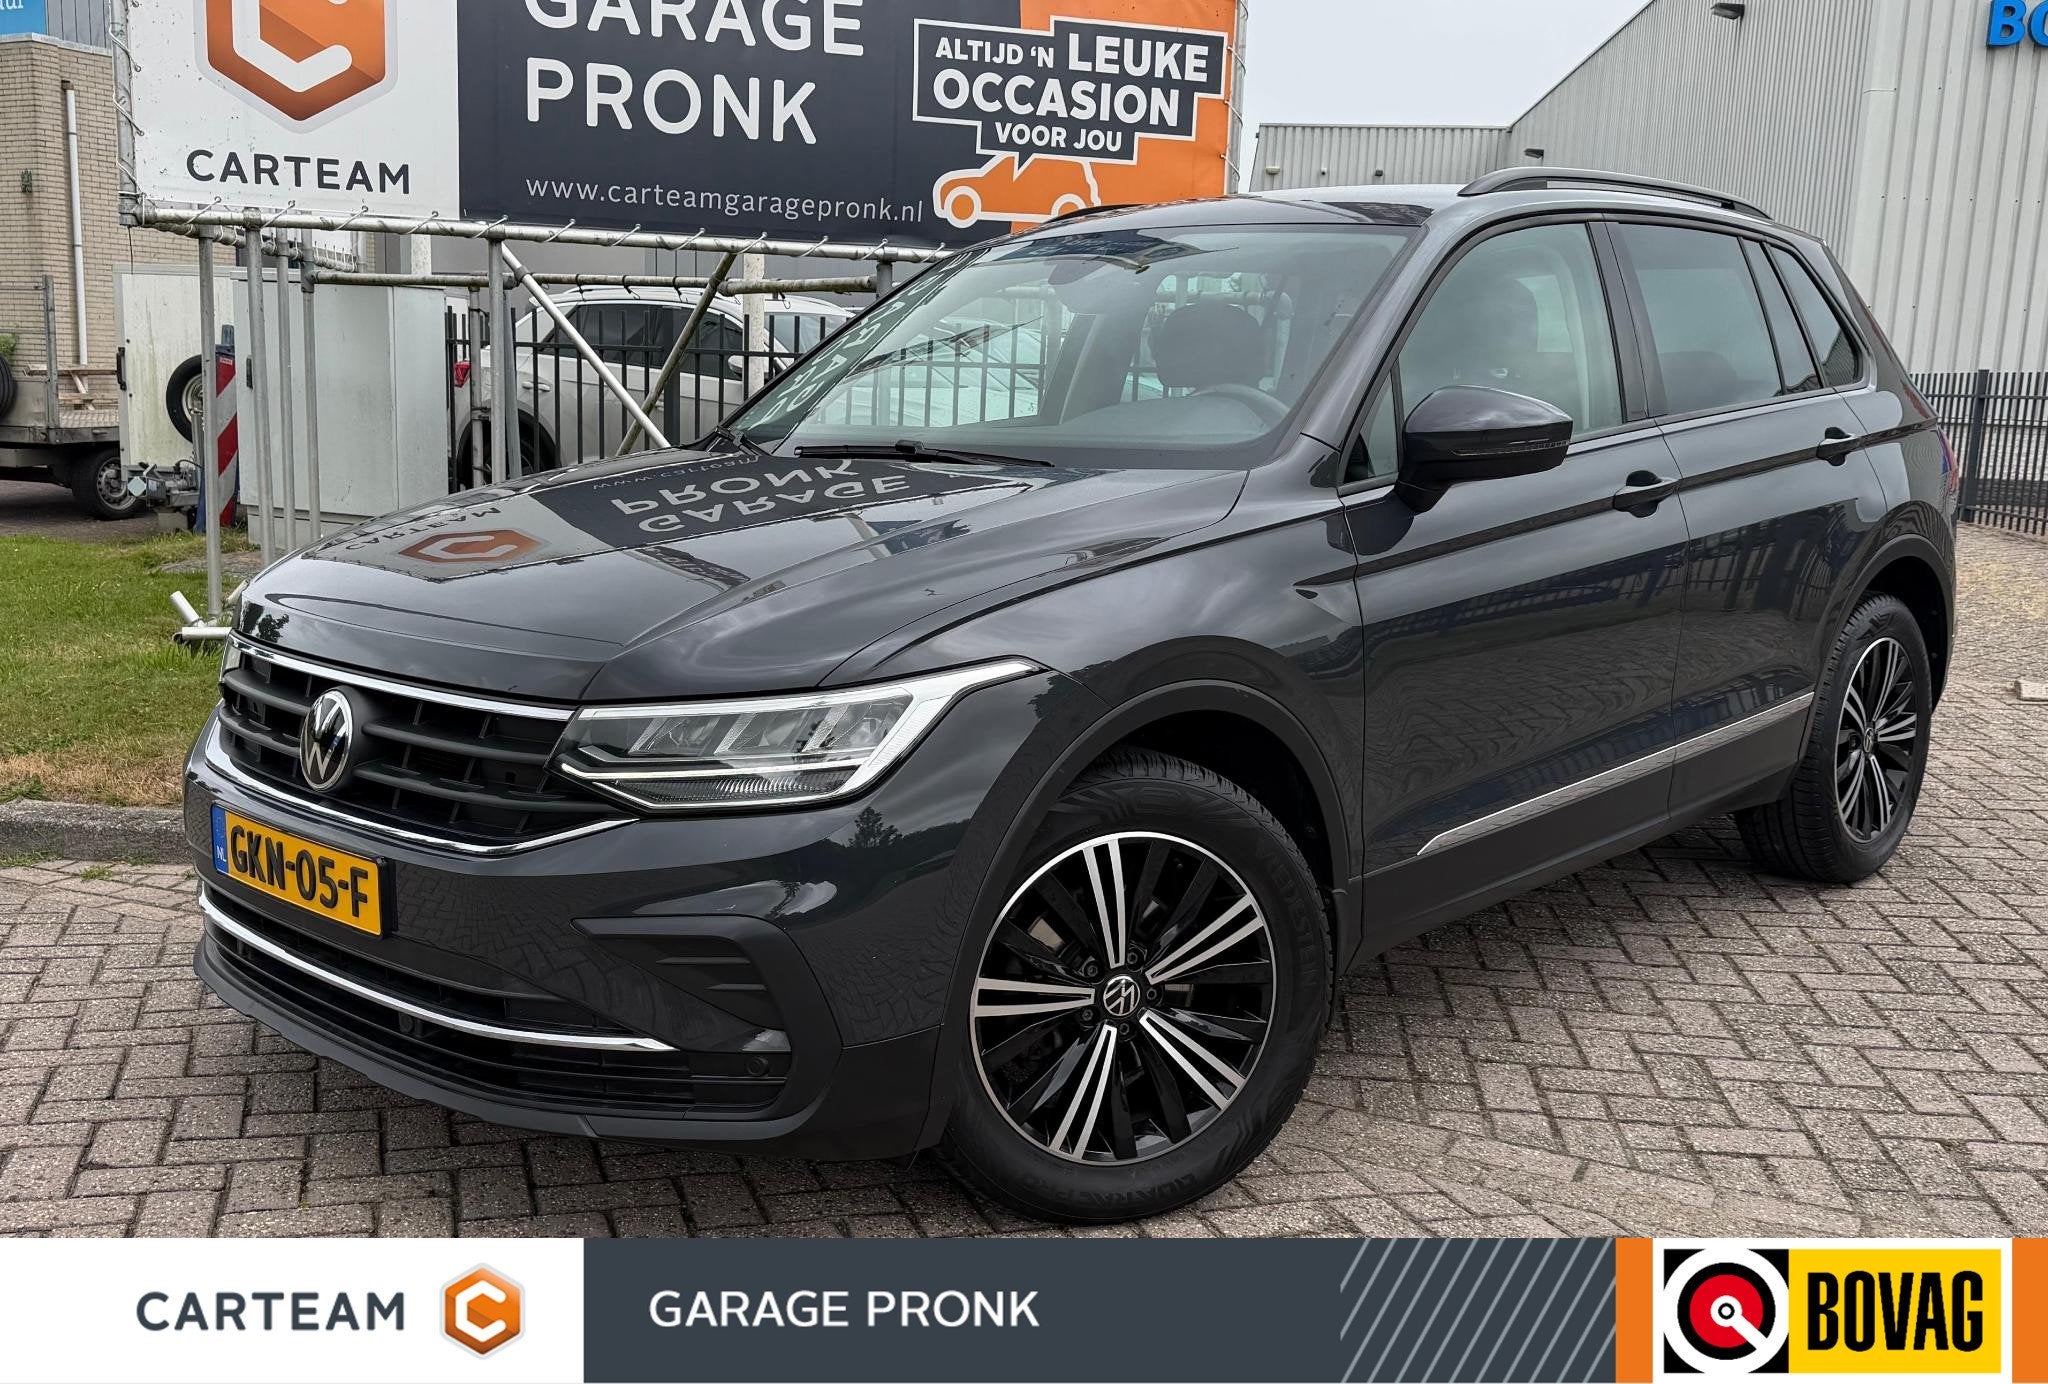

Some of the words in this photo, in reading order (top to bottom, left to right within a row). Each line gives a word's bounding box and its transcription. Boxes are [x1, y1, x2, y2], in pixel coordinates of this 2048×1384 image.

[934, 37, 1024, 66] ALTIJD
[1068, 32, 1210, 83] LEUKE
[526, 57, 817, 145] PRONK
[932, 68, 1180, 127] OCCASION
[994, 121, 1067, 148] VOOR
[1073, 128, 1123, 152] JOU
[186, 149, 410, 195] CARTEAM
[525, 178, 924, 223] www.carteamgaragepronk.nl
[230, 824, 369, 919] GKN-05-F
